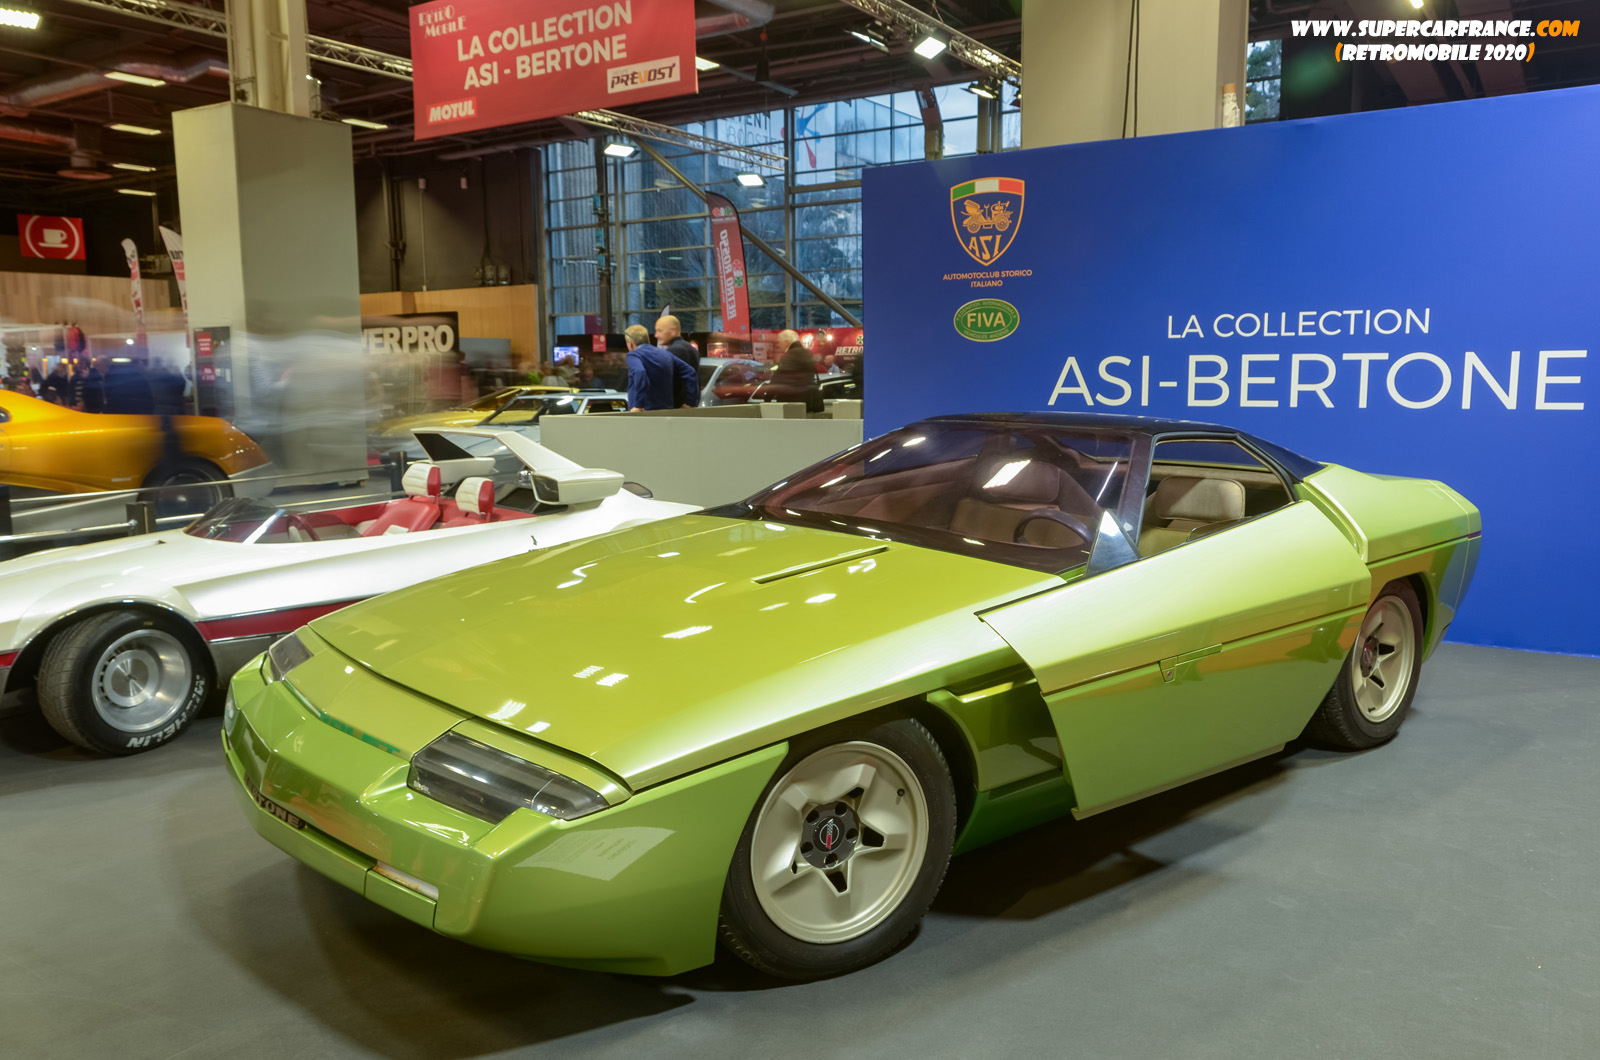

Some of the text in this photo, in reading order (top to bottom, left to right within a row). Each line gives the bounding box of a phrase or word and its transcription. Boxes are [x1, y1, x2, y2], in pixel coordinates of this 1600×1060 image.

[457, 0, 632, 62] LA COLLECTION
[464, 61, 498, 90] ASI
[516, 34, 627, 79] BERTONE
[429, 99, 475, 123] MOTUL
[968, 234, 1002, 261] ASI
[942, 269, 1033, 281] AUTOMOTOCLUB STORICO
[970, 279, 1003, 288] ITALIANO
[967, 311, 1006, 328] FIVA
[1167, 308, 1430, 338] LA COLLECTION
[1049, 350, 1587, 410] ASI-BERTONE
[126, 674, 205, 748] MICHELIN
